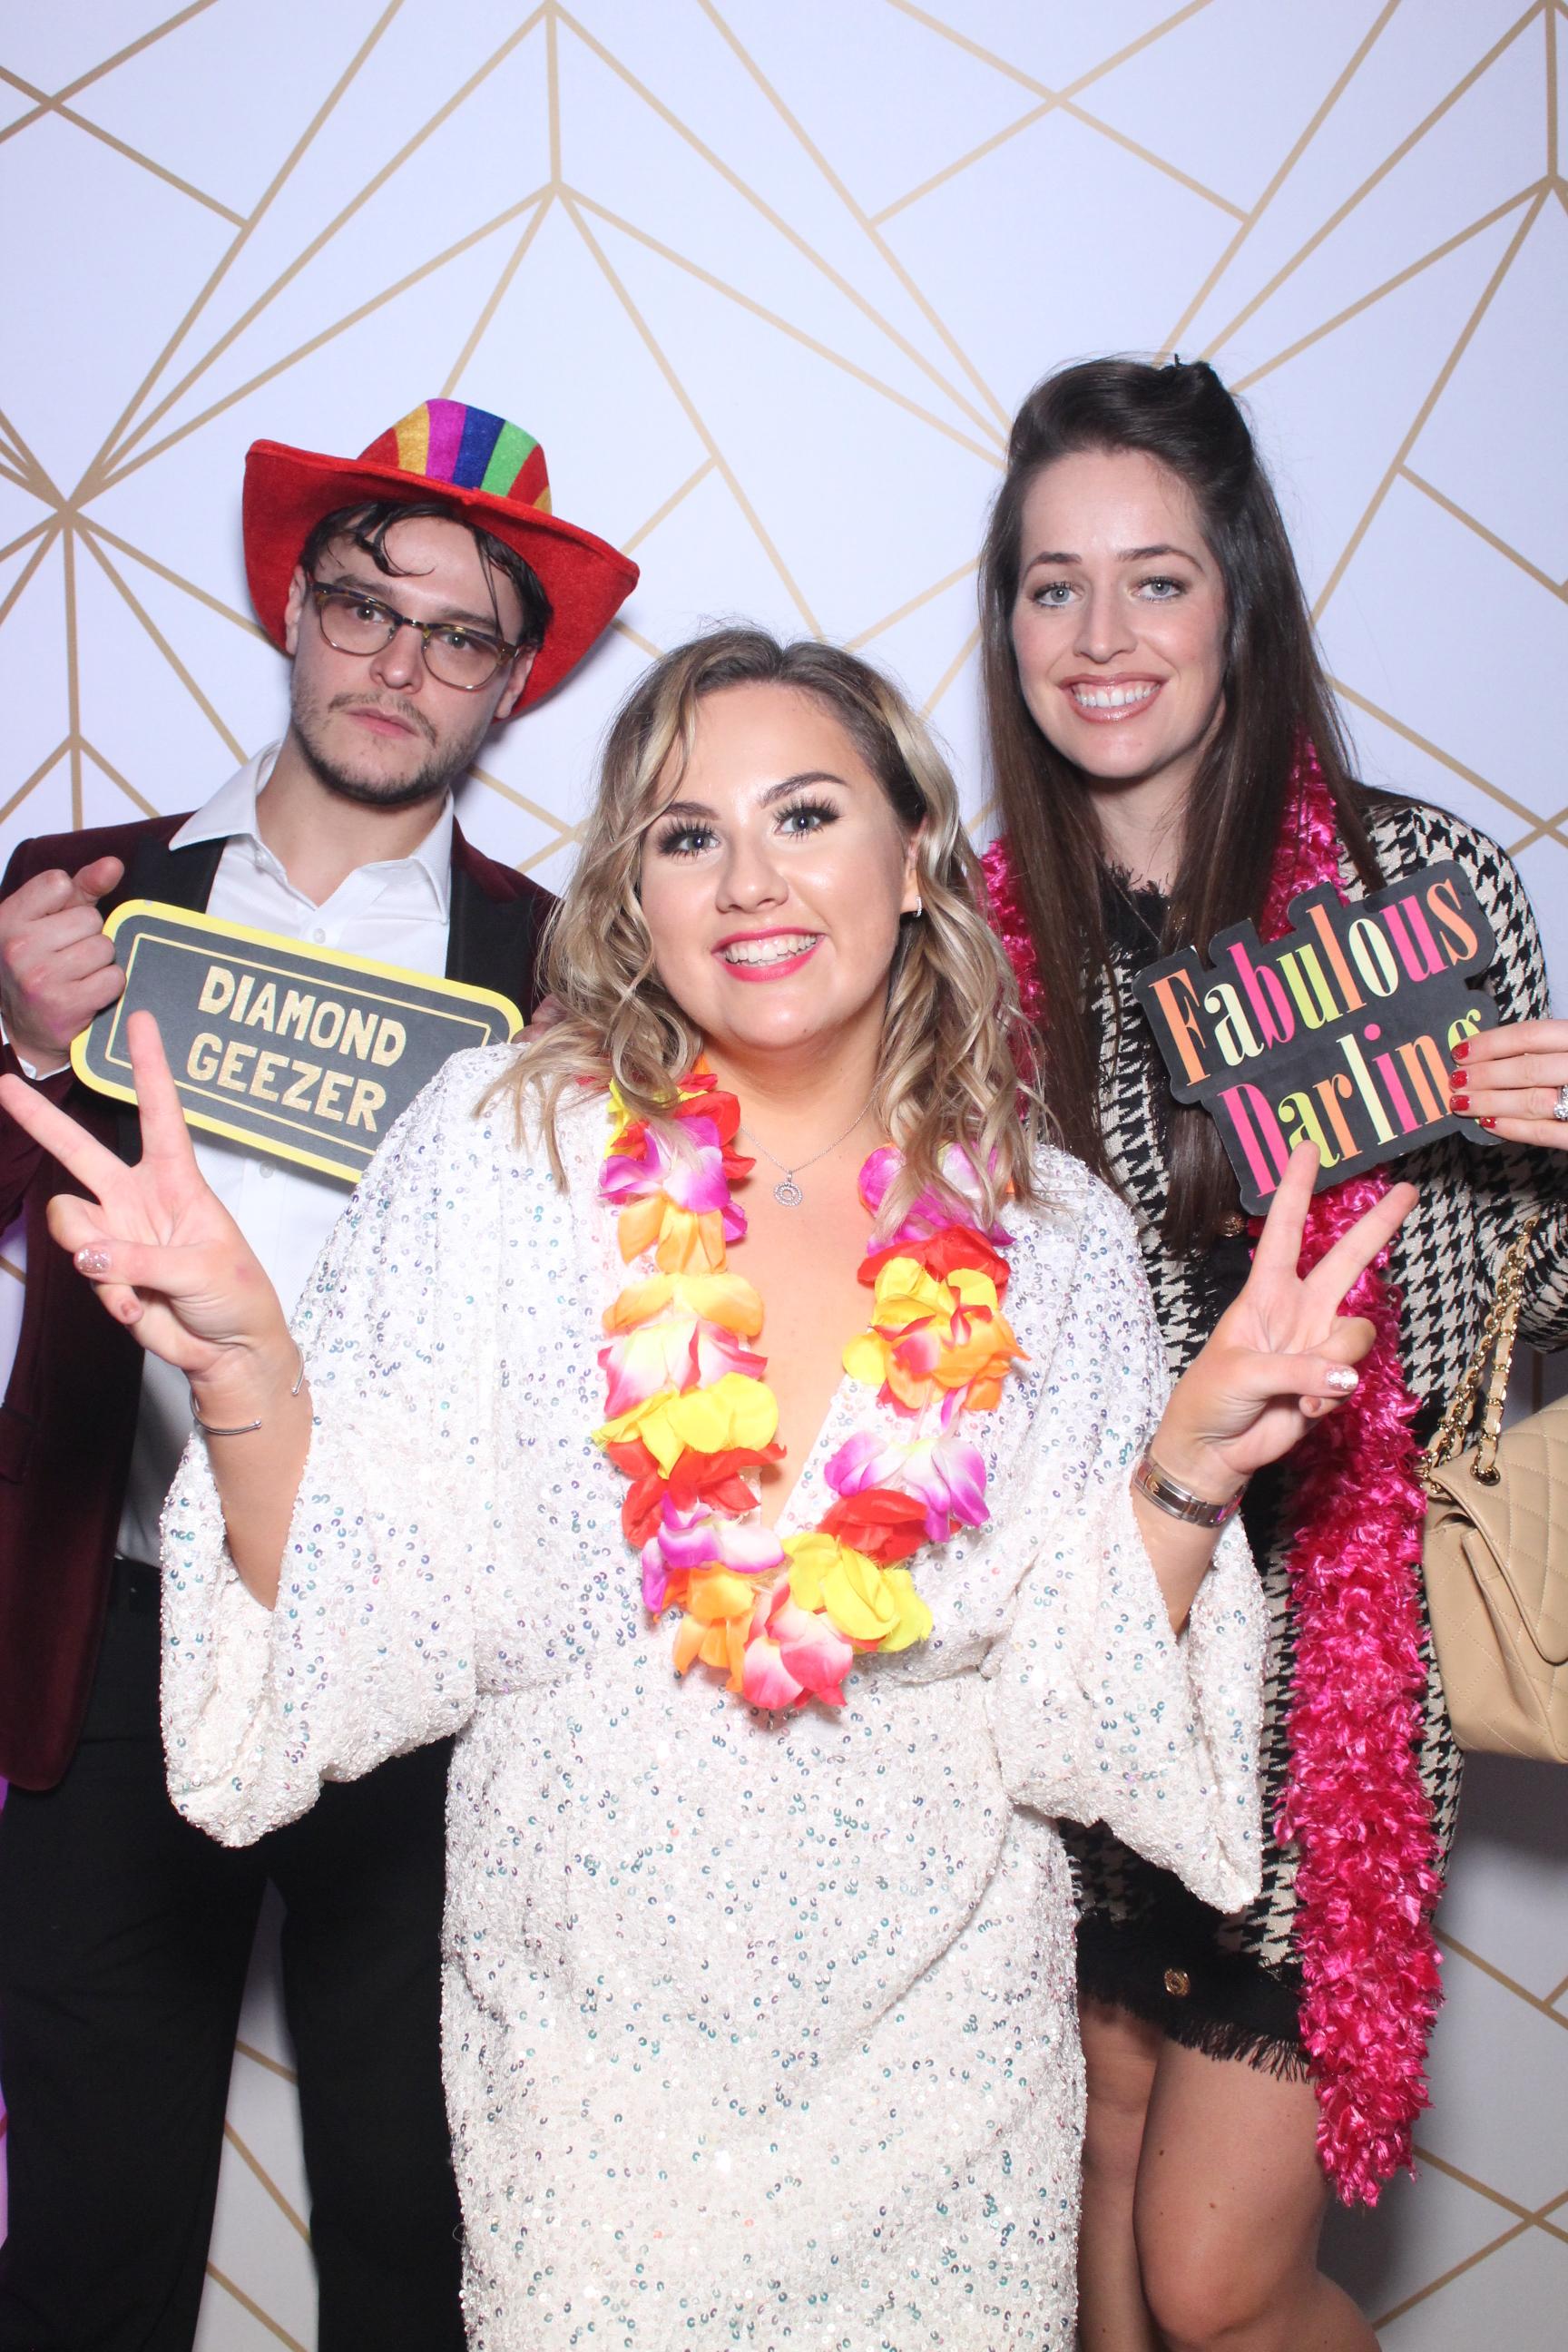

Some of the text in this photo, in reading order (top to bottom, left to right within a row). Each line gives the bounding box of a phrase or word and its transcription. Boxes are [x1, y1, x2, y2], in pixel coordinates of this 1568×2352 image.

[198, 965, 407, 1067] DIAMOND
[1148, 878, 1479, 1086] Fabulous
[187, 1033, 387, 1132] GEEZER
